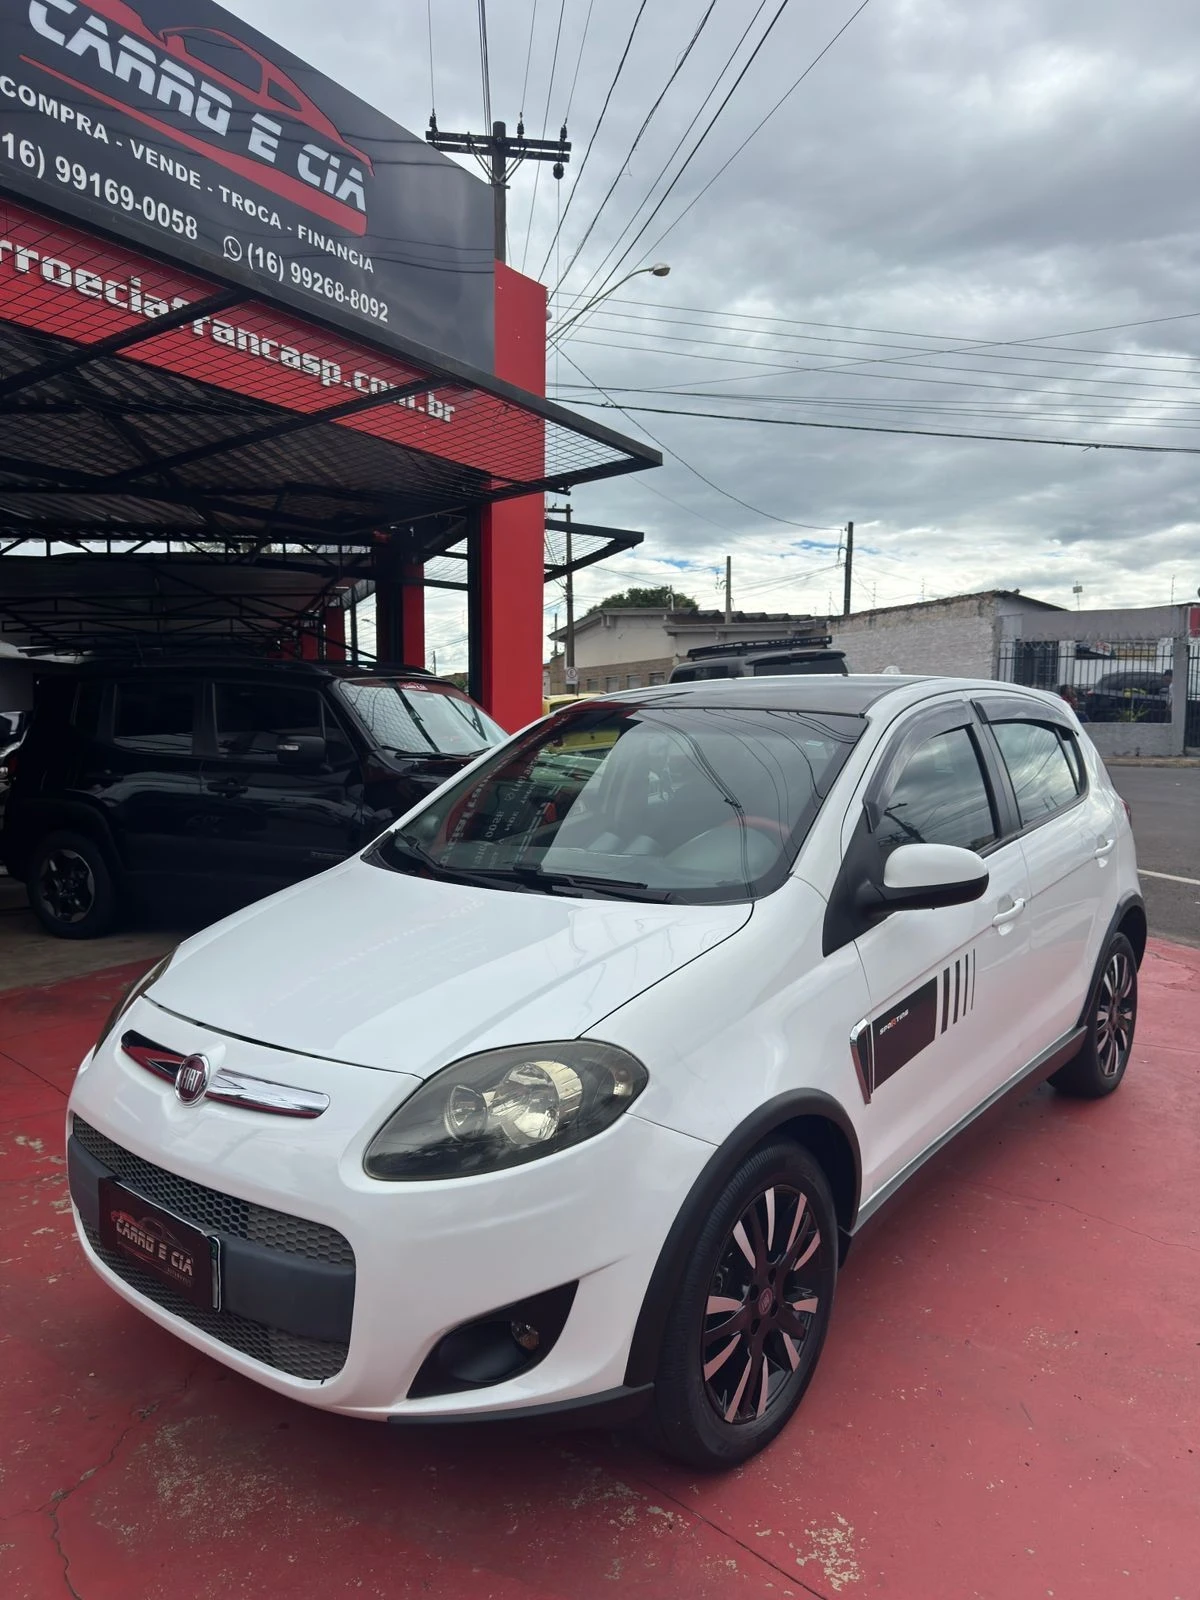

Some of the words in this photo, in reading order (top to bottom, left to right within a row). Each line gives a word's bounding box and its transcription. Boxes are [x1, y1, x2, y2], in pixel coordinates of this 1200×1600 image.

[248, 113, 283, 163] E
[0, 75, 109, 144] COMPRA
[130, 139, 201, 190] VENDE
[218, 185, 282, 229] TROCA
[298, 225, 374, 273] FINANCIA
[55, 156, 197, 240] 99169-0058
[248, 243, 284, 282] (16)
[290, 262, 388, 322] 99268-8092
[181, 1067, 202, 1092] FIAT
[158, 1242, 168, 1260] E
